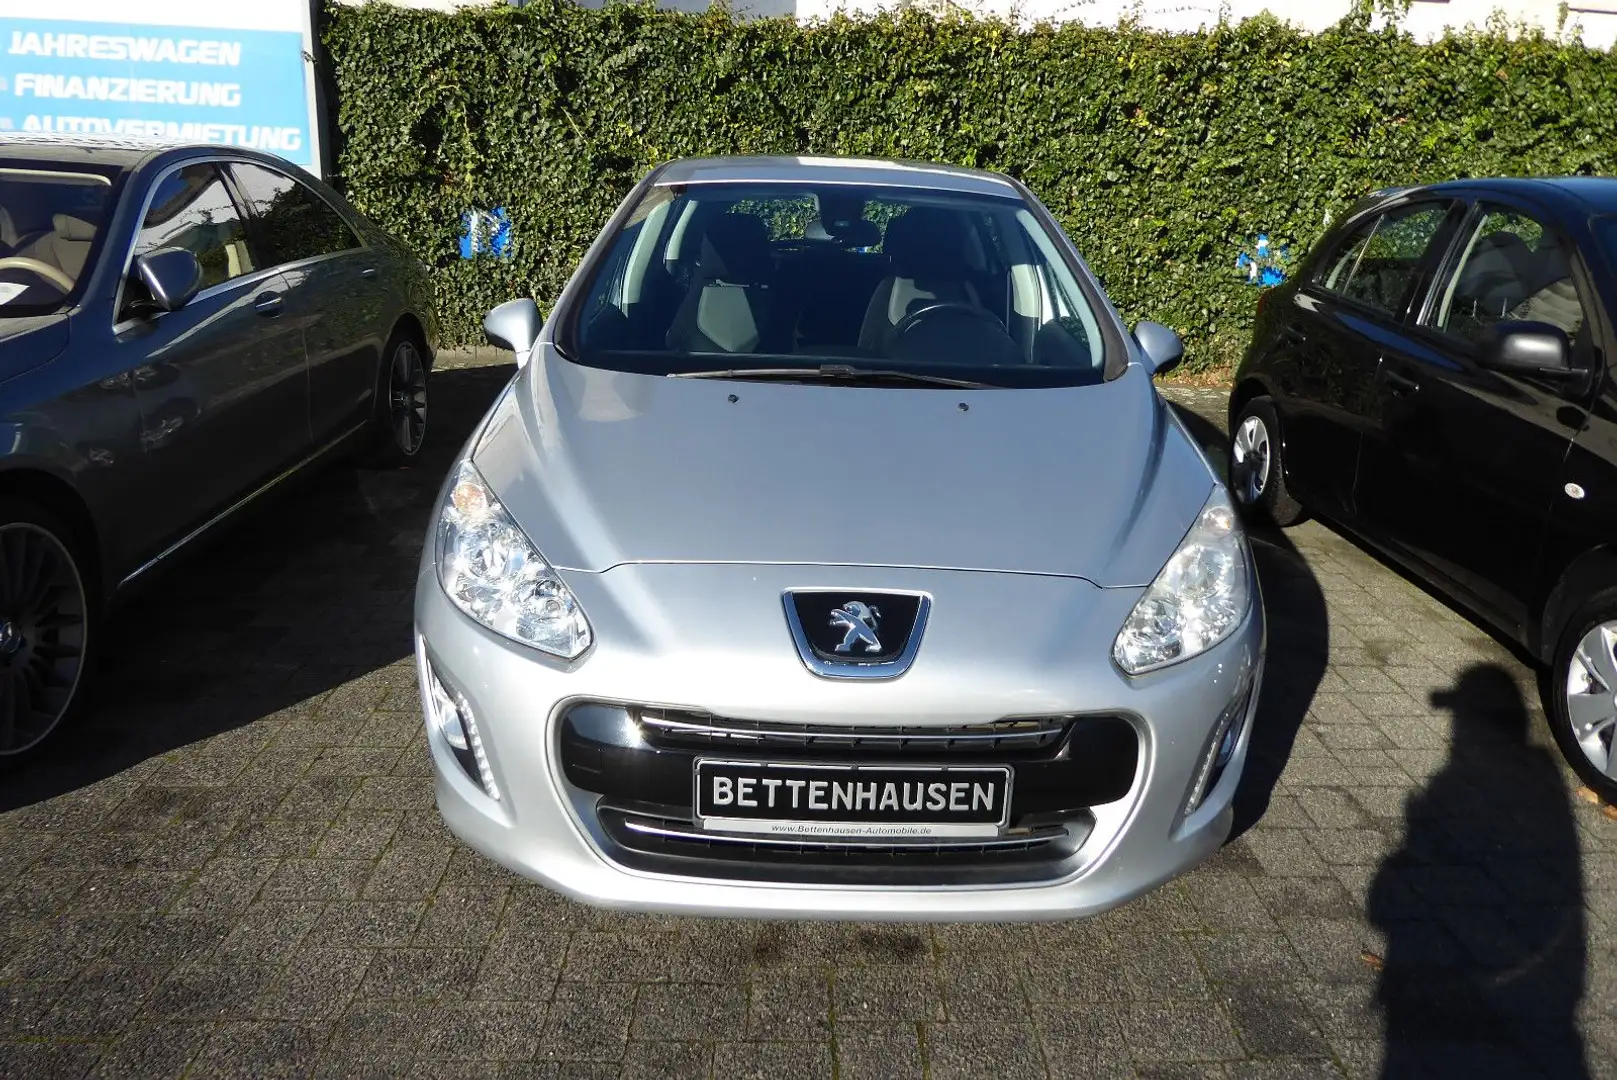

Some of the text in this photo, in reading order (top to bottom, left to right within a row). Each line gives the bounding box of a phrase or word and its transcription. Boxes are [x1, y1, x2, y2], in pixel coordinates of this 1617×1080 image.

[9, 30, 241, 66] JAHRESWAGEN
[14, 73, 241, 107] FINANZIERUNG
[22, 114, 301, 150] AUTOVERMIETUNG
[713, 776, 994, 811] BETTENHAUSEN
[771, 825, 932, 835] www.Bettenhausen-Automobile.de
